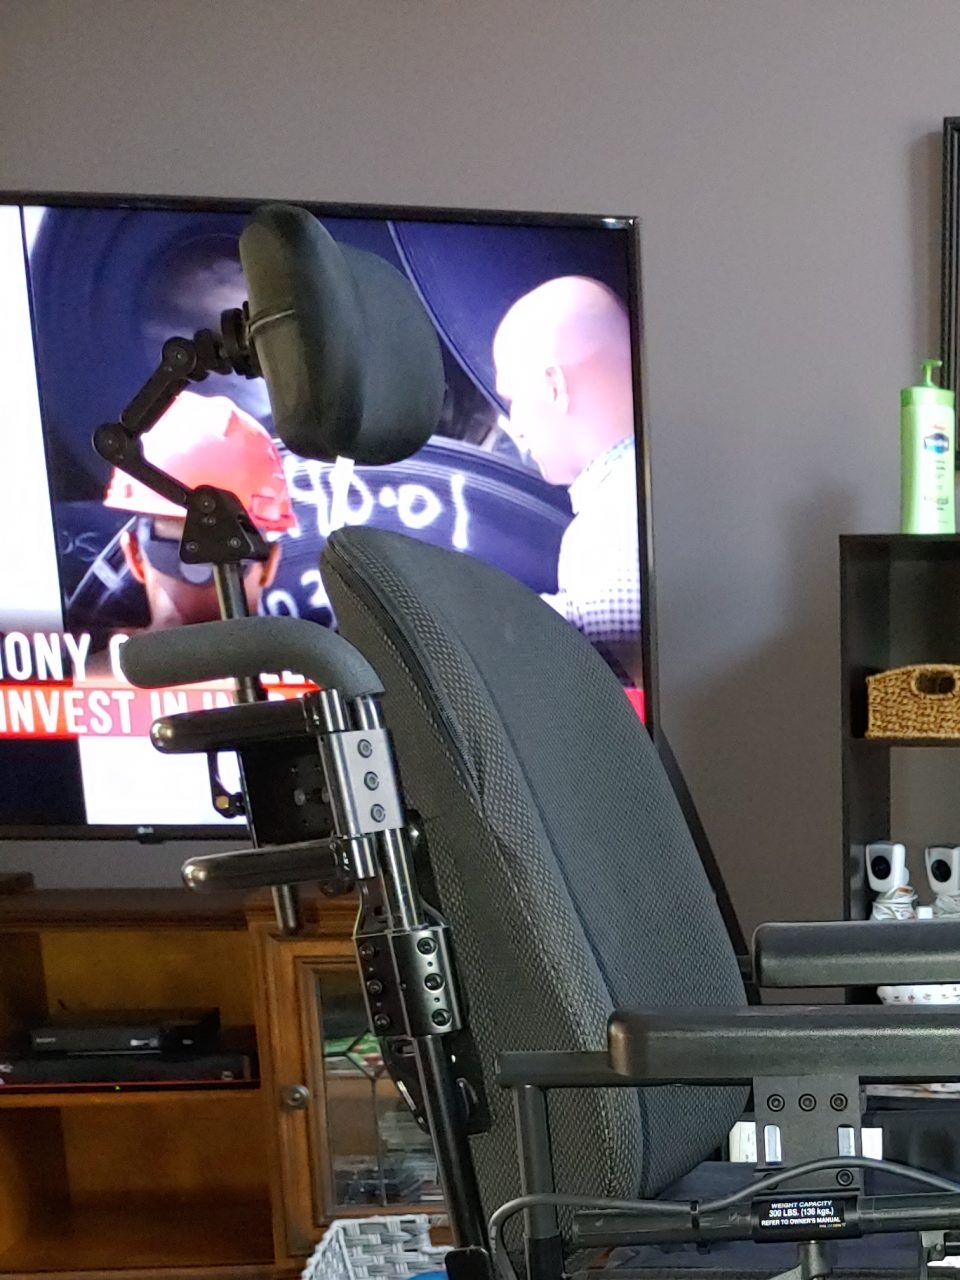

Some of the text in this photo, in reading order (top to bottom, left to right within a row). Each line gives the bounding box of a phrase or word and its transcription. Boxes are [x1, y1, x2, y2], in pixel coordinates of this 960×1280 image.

[0, 631, 91, 681] ONY
[0, 688, 135, 734] INVEST
[761, 1219, 780, 1227] REFER
